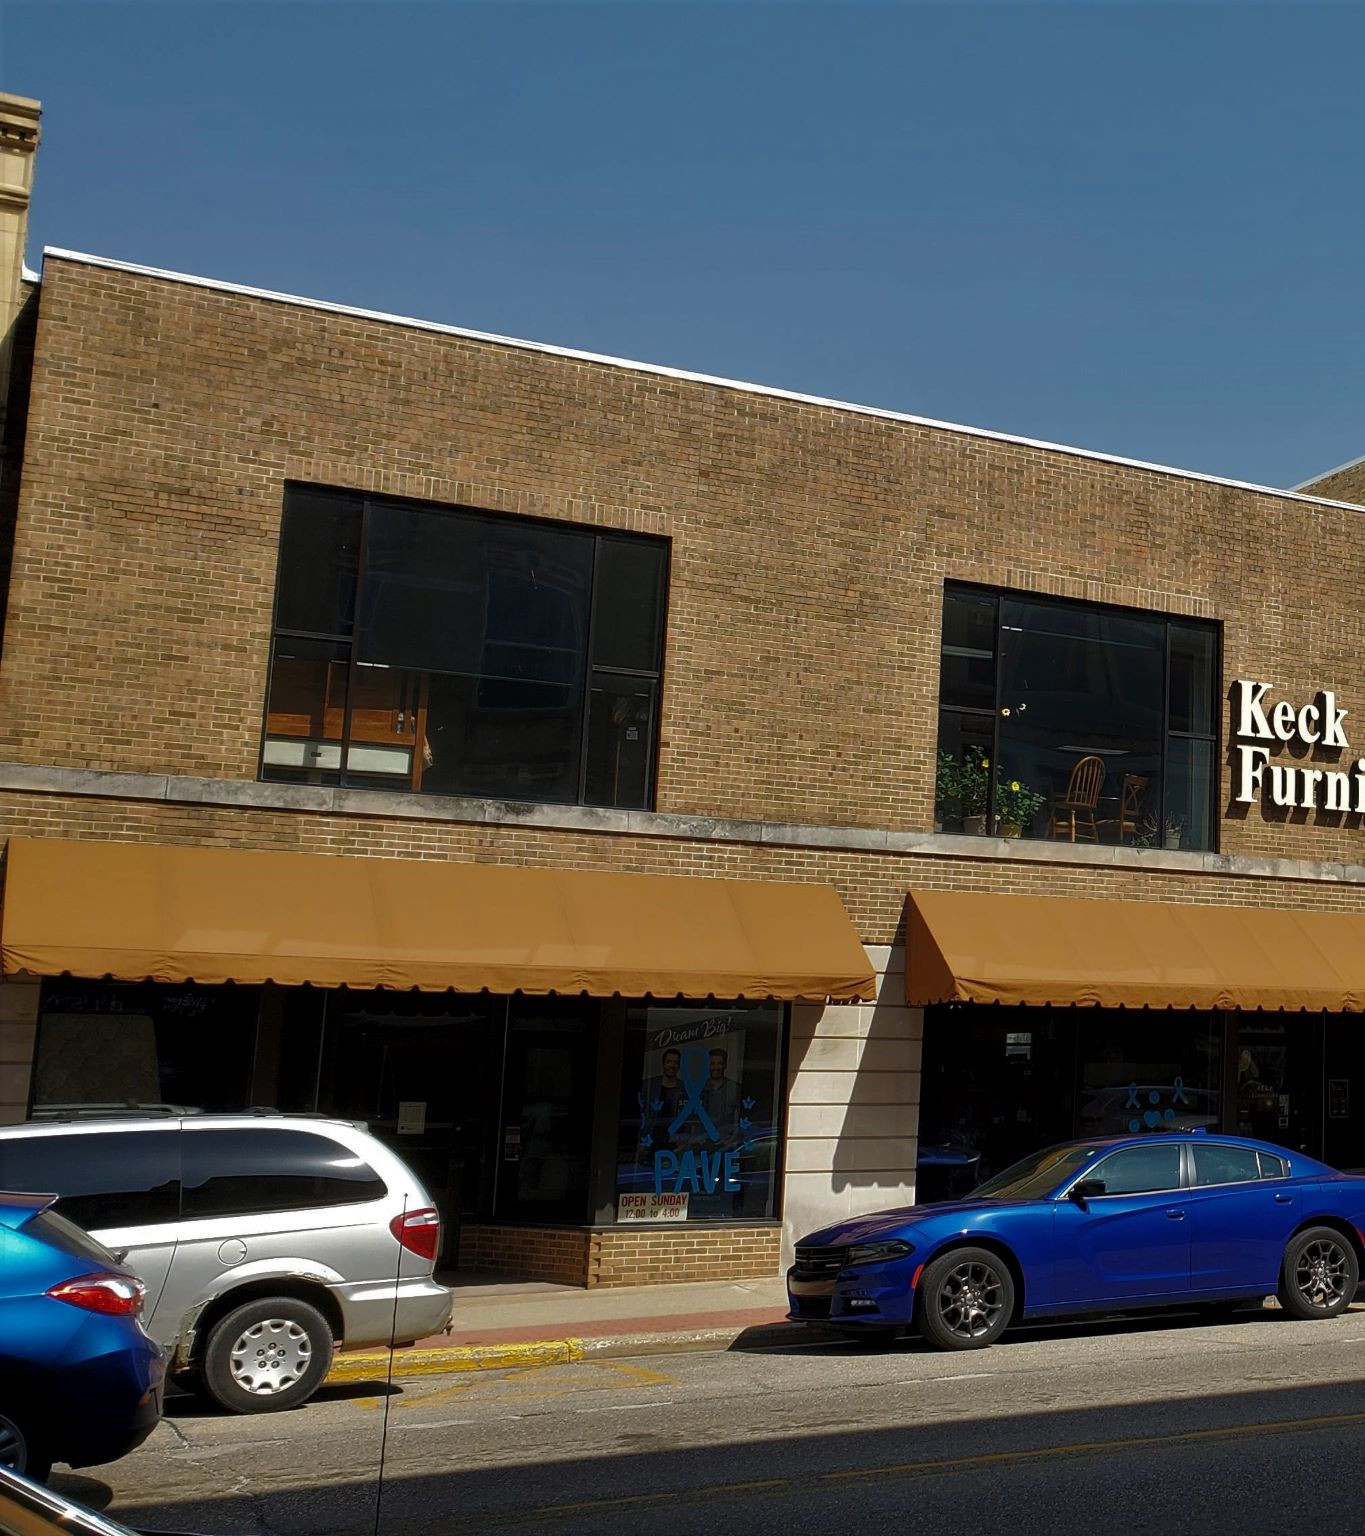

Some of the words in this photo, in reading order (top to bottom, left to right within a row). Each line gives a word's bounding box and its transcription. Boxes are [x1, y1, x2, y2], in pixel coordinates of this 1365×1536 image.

[1237, 680, 1350, 748] Keck
[654, 1028, 699, 1048] Dream
[702, 1015, 732, 1037] Big!
[655, 1150, 741, 1195] PAVE
[621, 1195, 647, 1208] OPEN
[651, 1194, 688, 1207] SUNDAY
[625, 1208, 646, 1219] 12:00
[650, 1208, 659, 1218] to
[662, 1207, 680, 1218] 4:00
